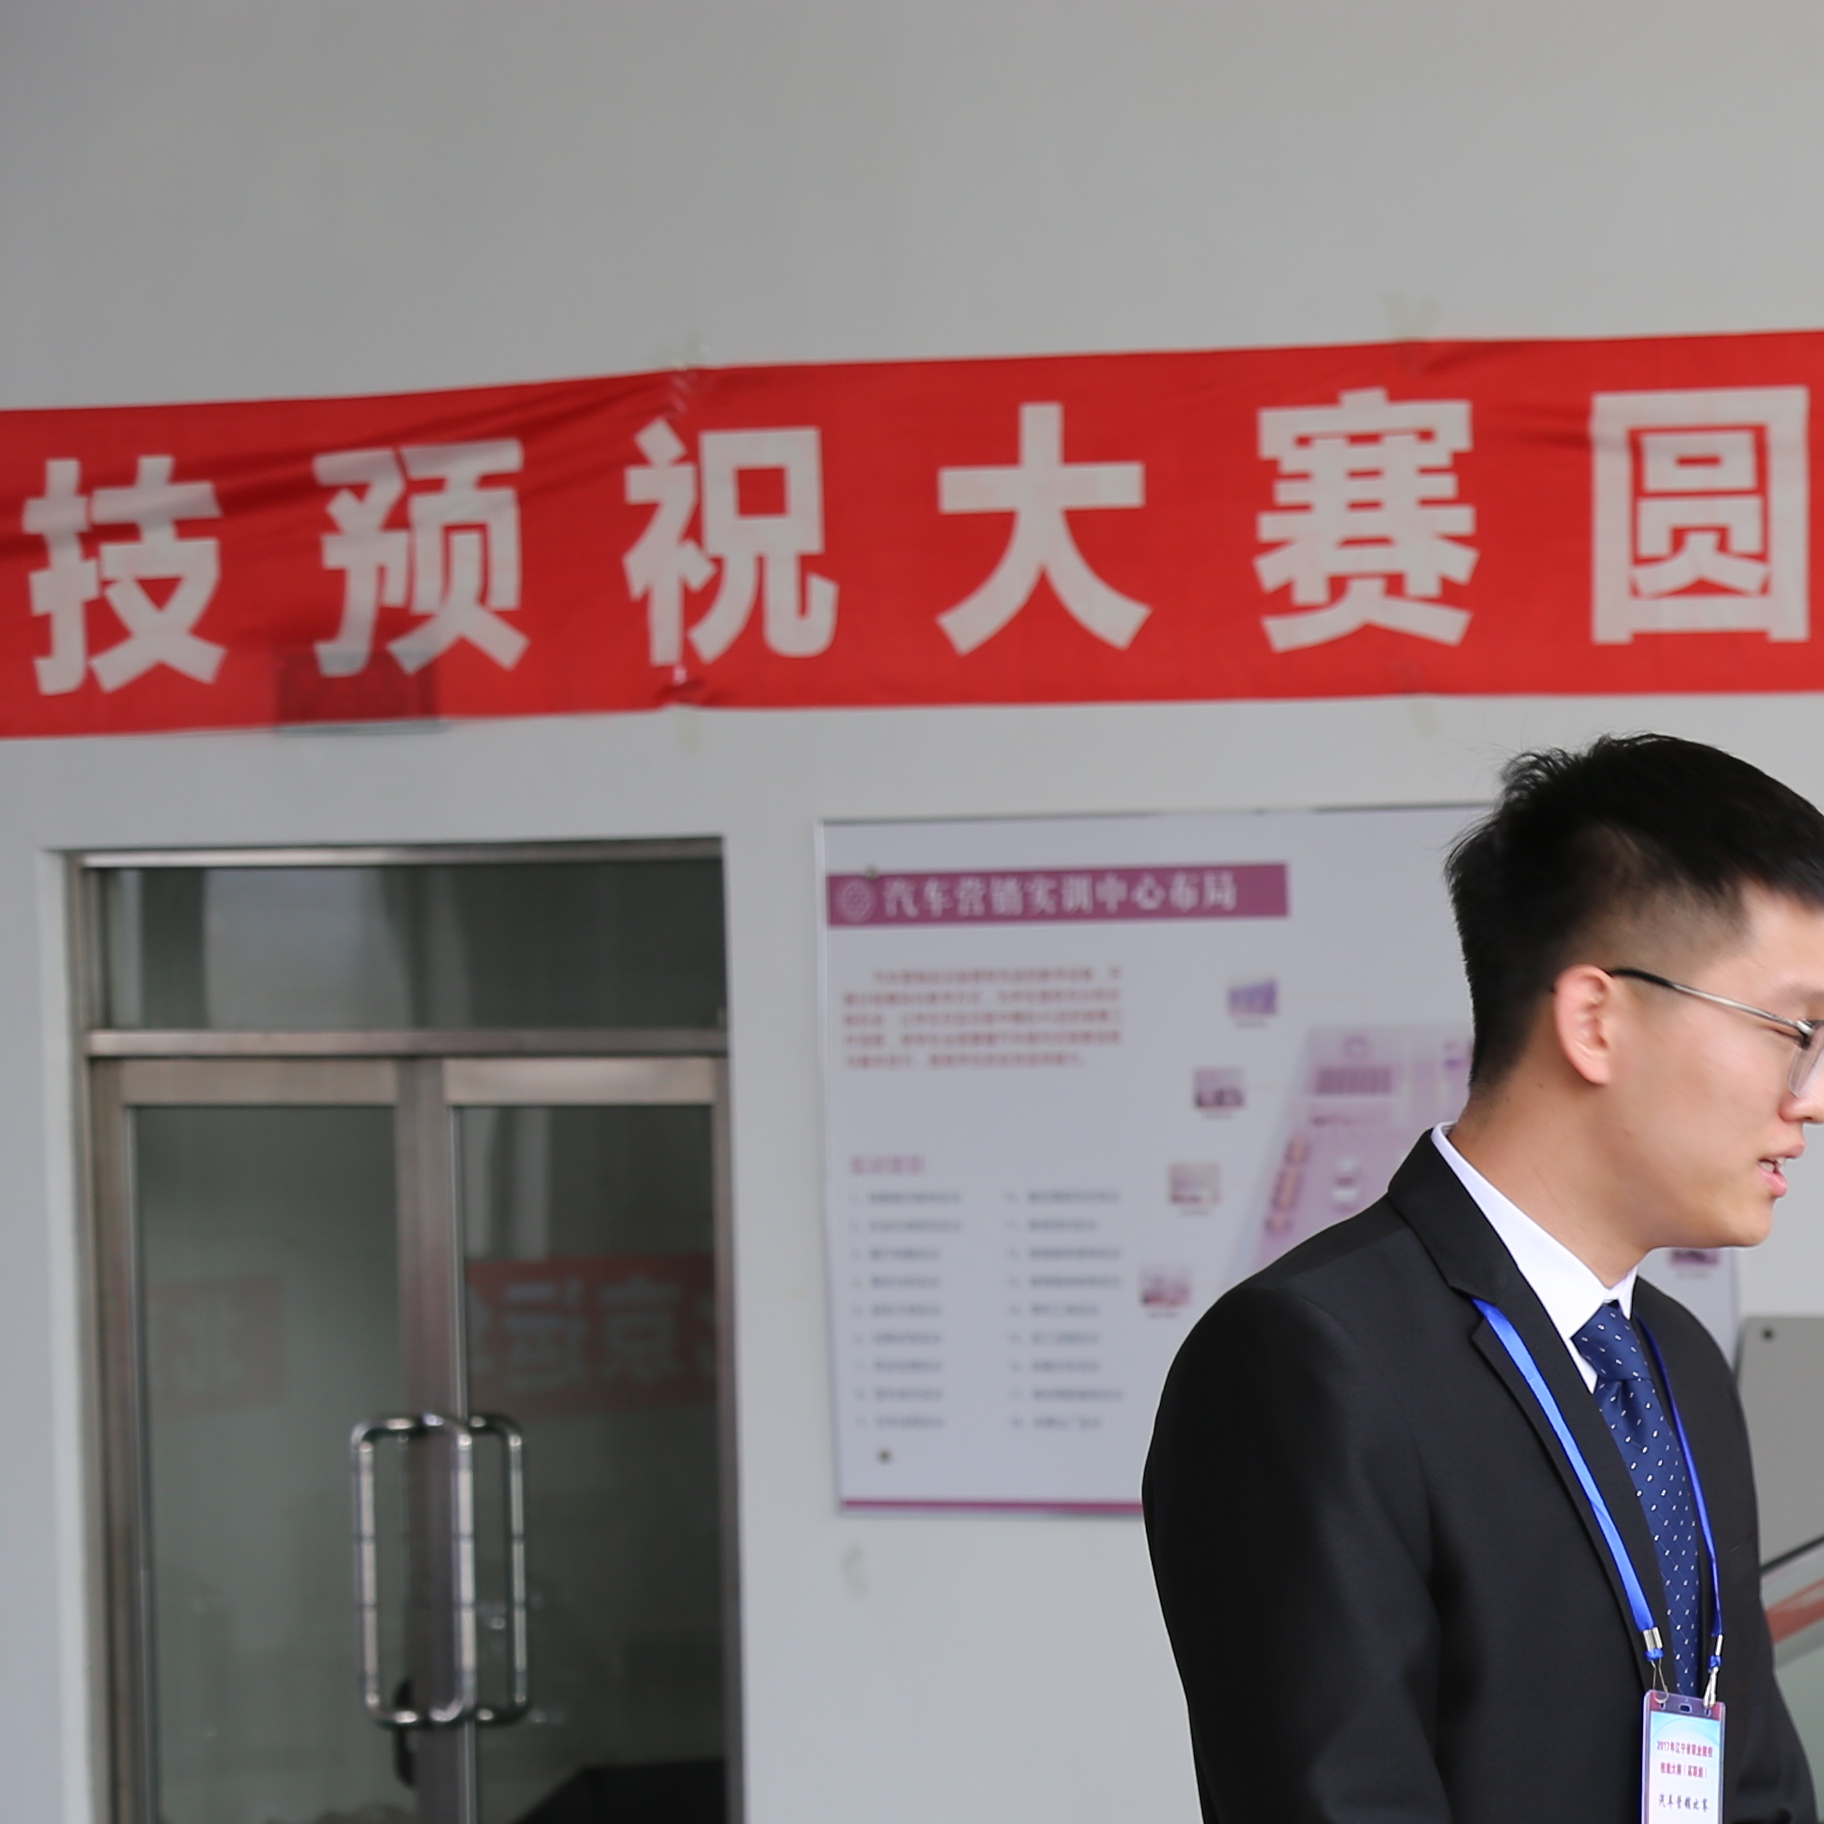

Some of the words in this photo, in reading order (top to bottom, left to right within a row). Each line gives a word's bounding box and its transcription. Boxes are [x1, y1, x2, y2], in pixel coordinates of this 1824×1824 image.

[883, 870, 1238, 919] 汽车营销实训中心布局
